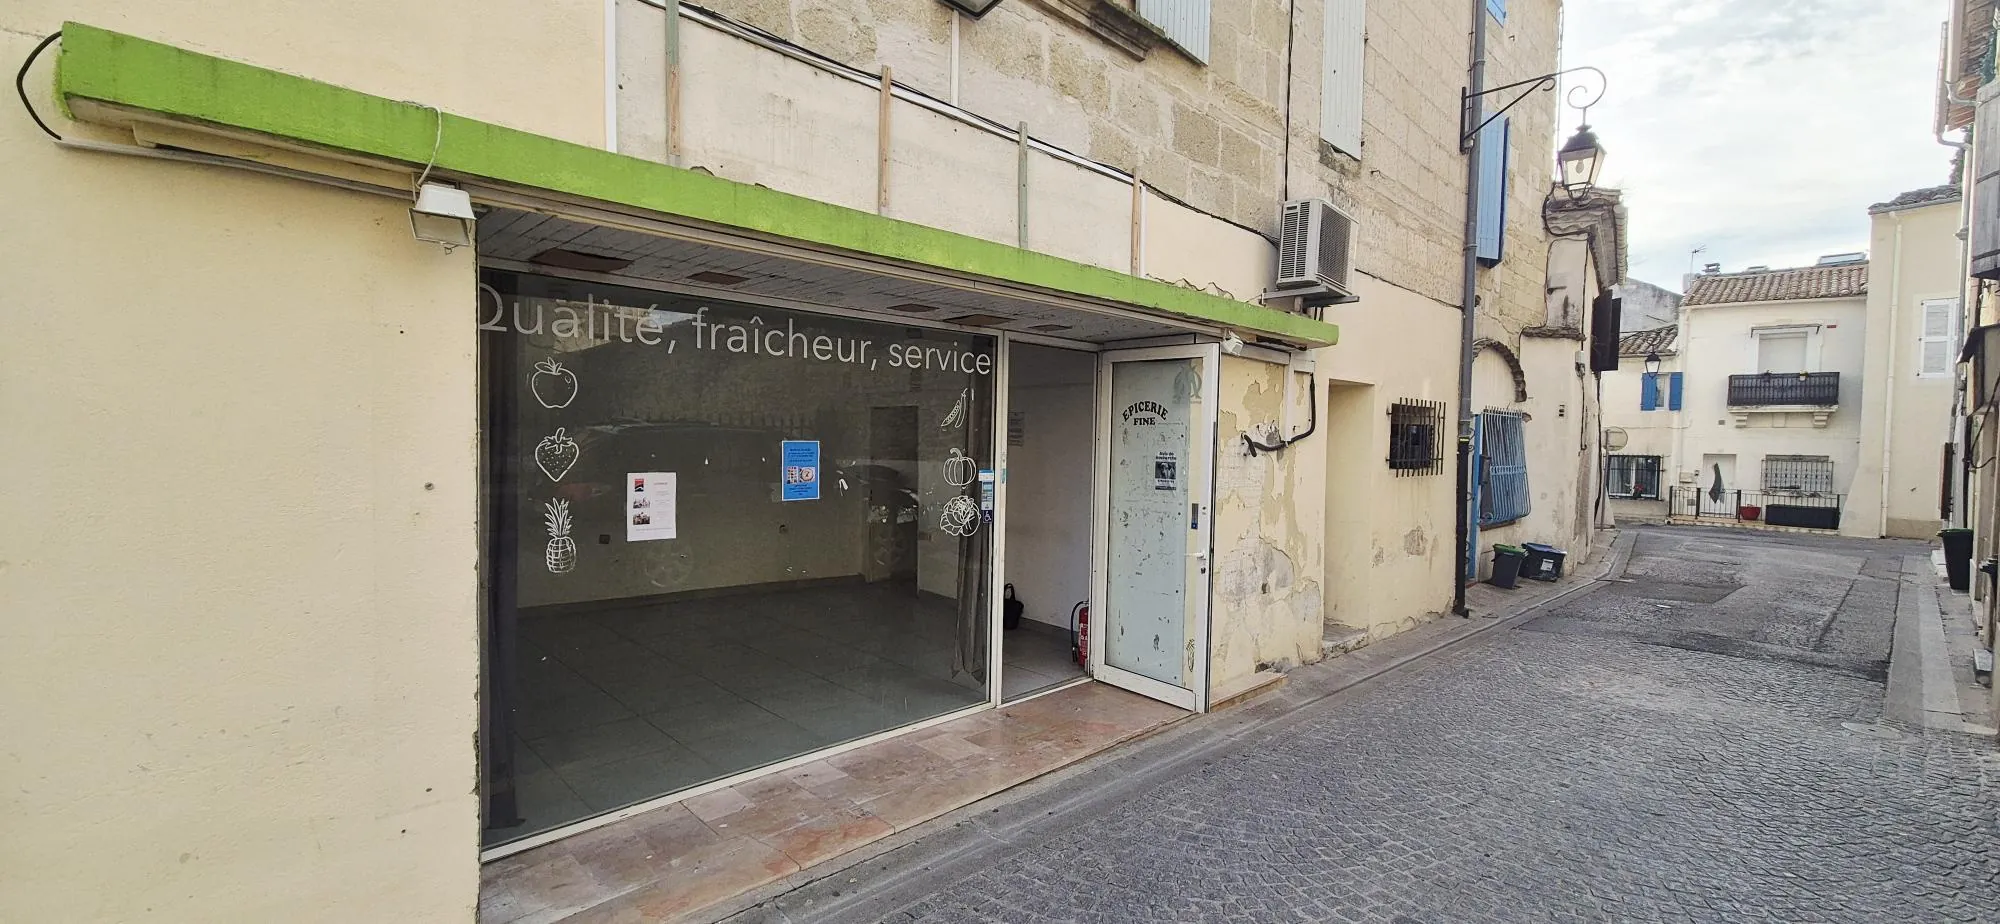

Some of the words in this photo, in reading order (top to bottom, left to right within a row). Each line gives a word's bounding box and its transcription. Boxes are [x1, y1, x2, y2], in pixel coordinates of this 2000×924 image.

[692, 306, 878, 371] fraîcheur,
[888, 341, 992, 375] service
[1122, 401, 1169, 422] EPICERIE
[1133, 417, 1156, 426] FINE
